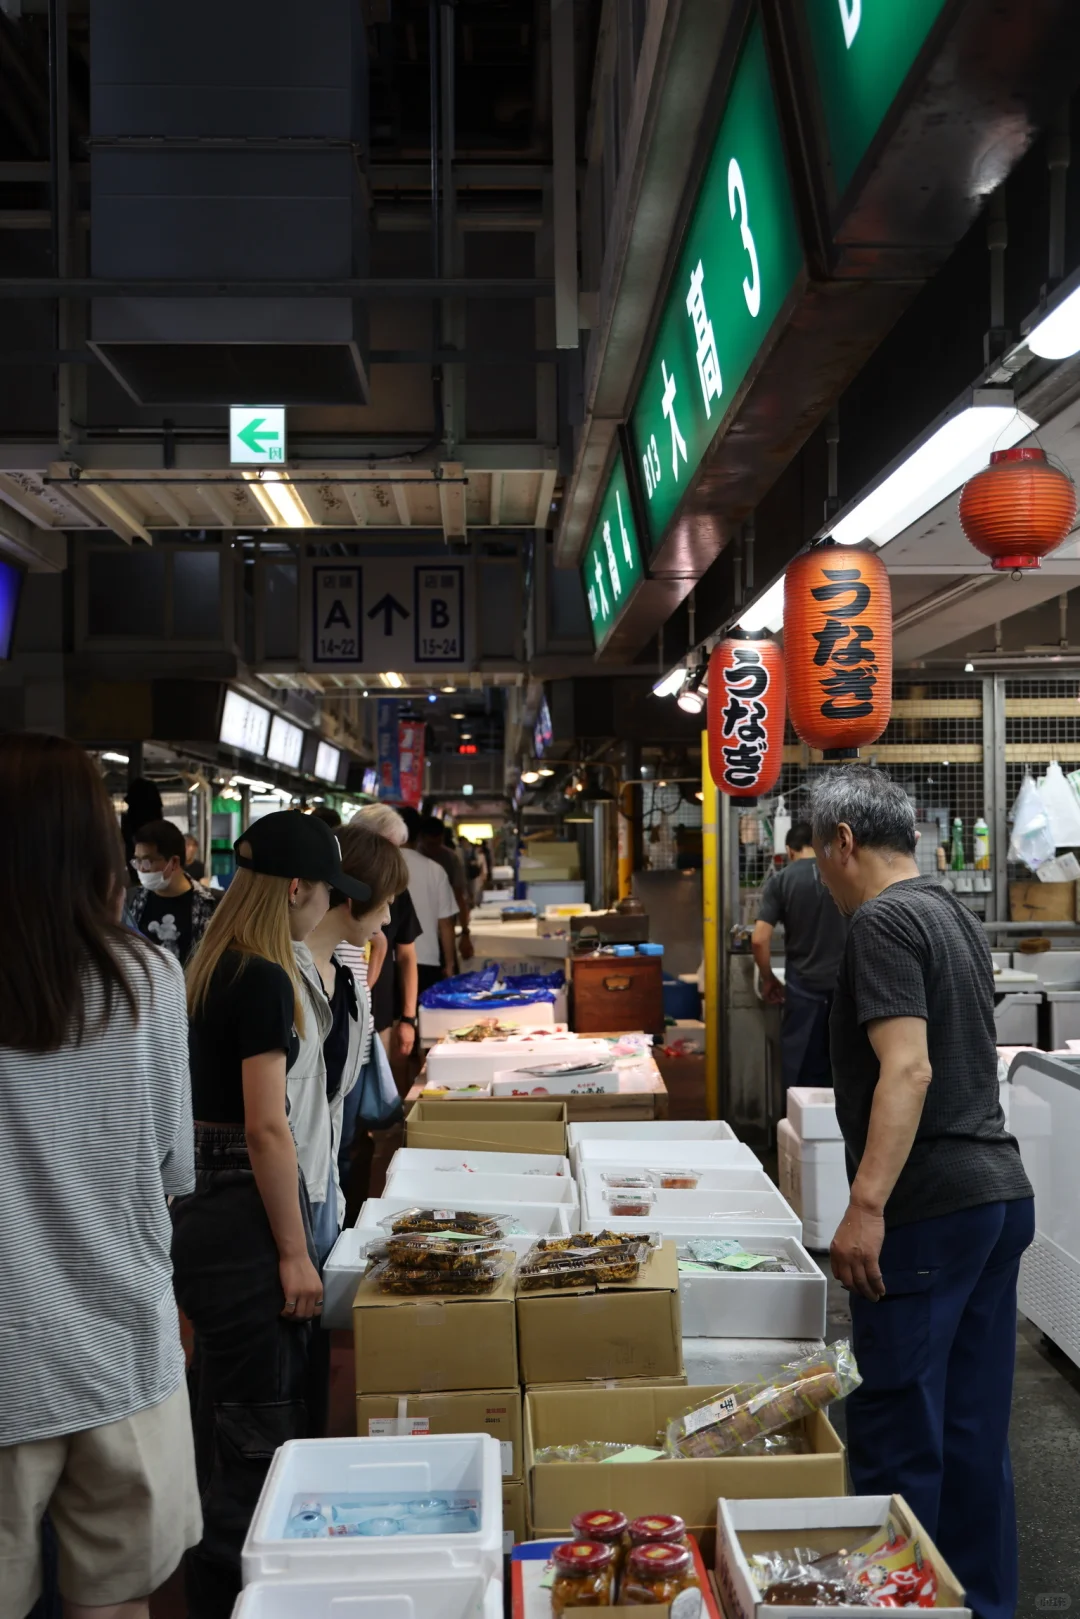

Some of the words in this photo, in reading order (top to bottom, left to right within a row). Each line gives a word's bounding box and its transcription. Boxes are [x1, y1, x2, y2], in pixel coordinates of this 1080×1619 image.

[642, 433, 661, 500] B13
[727, 157, 761, 318] 3
[324, 600, 351, 629] A
[431, 599, 450, 629] B
[810, 568, 879, 719] うなぎ
[722, 648, 770, 789] うなぎ
